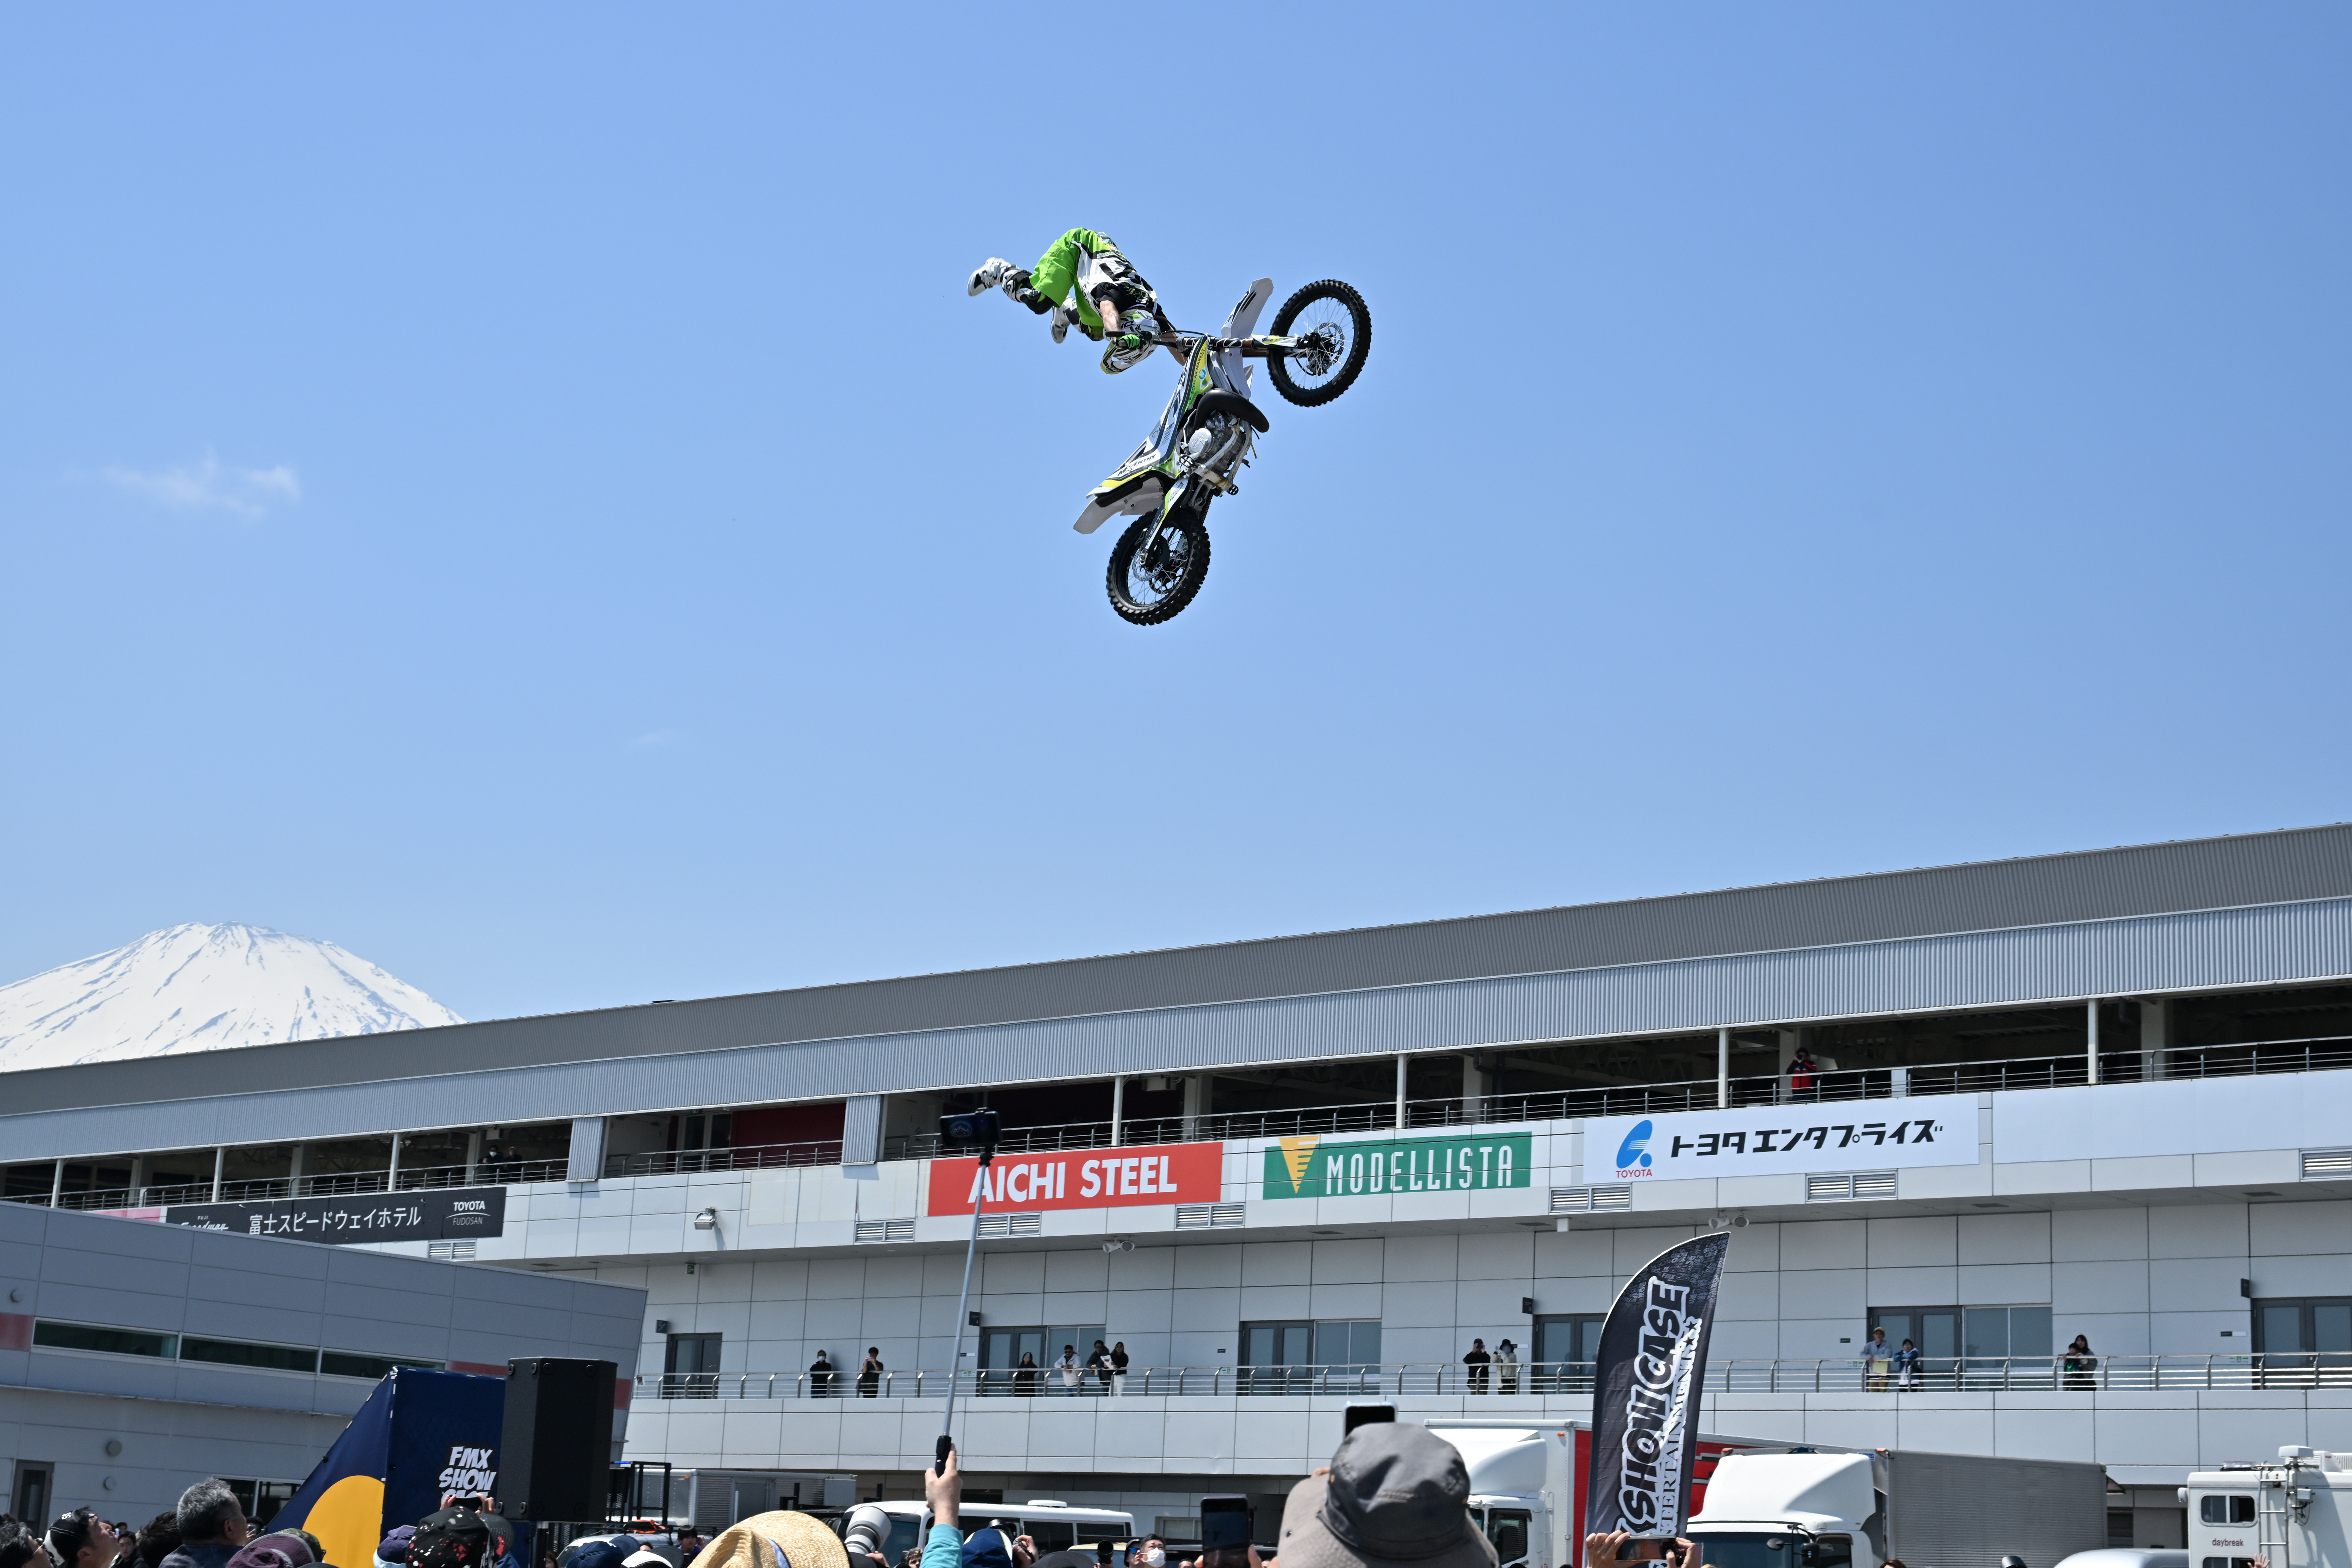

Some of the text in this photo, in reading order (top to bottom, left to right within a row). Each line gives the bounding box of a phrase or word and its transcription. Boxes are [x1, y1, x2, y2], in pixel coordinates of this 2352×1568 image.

[1196, 348, 1206, 370] MARKET
[967, 1155, 1178, 1203] AICHI STEEL
[1326, 1145, 1513, 1195] MODELLISTA
[1615, 1168, 1653, 1178] TOYOTA
[453, 1201, 485, 1211] TOYOTA
[249, 1206, 422, 1235] 富士スピードウェイホテル
[452, 1216, 483, 1226] FUDOSAN
[1620, 1279, 1687, 1524] SHOWCASE
[449, 1446, 493, 1470] FMX
[438, 1467, 497, 1490] SHOW
[2212, 1538, 2244, 1547] daybreak
